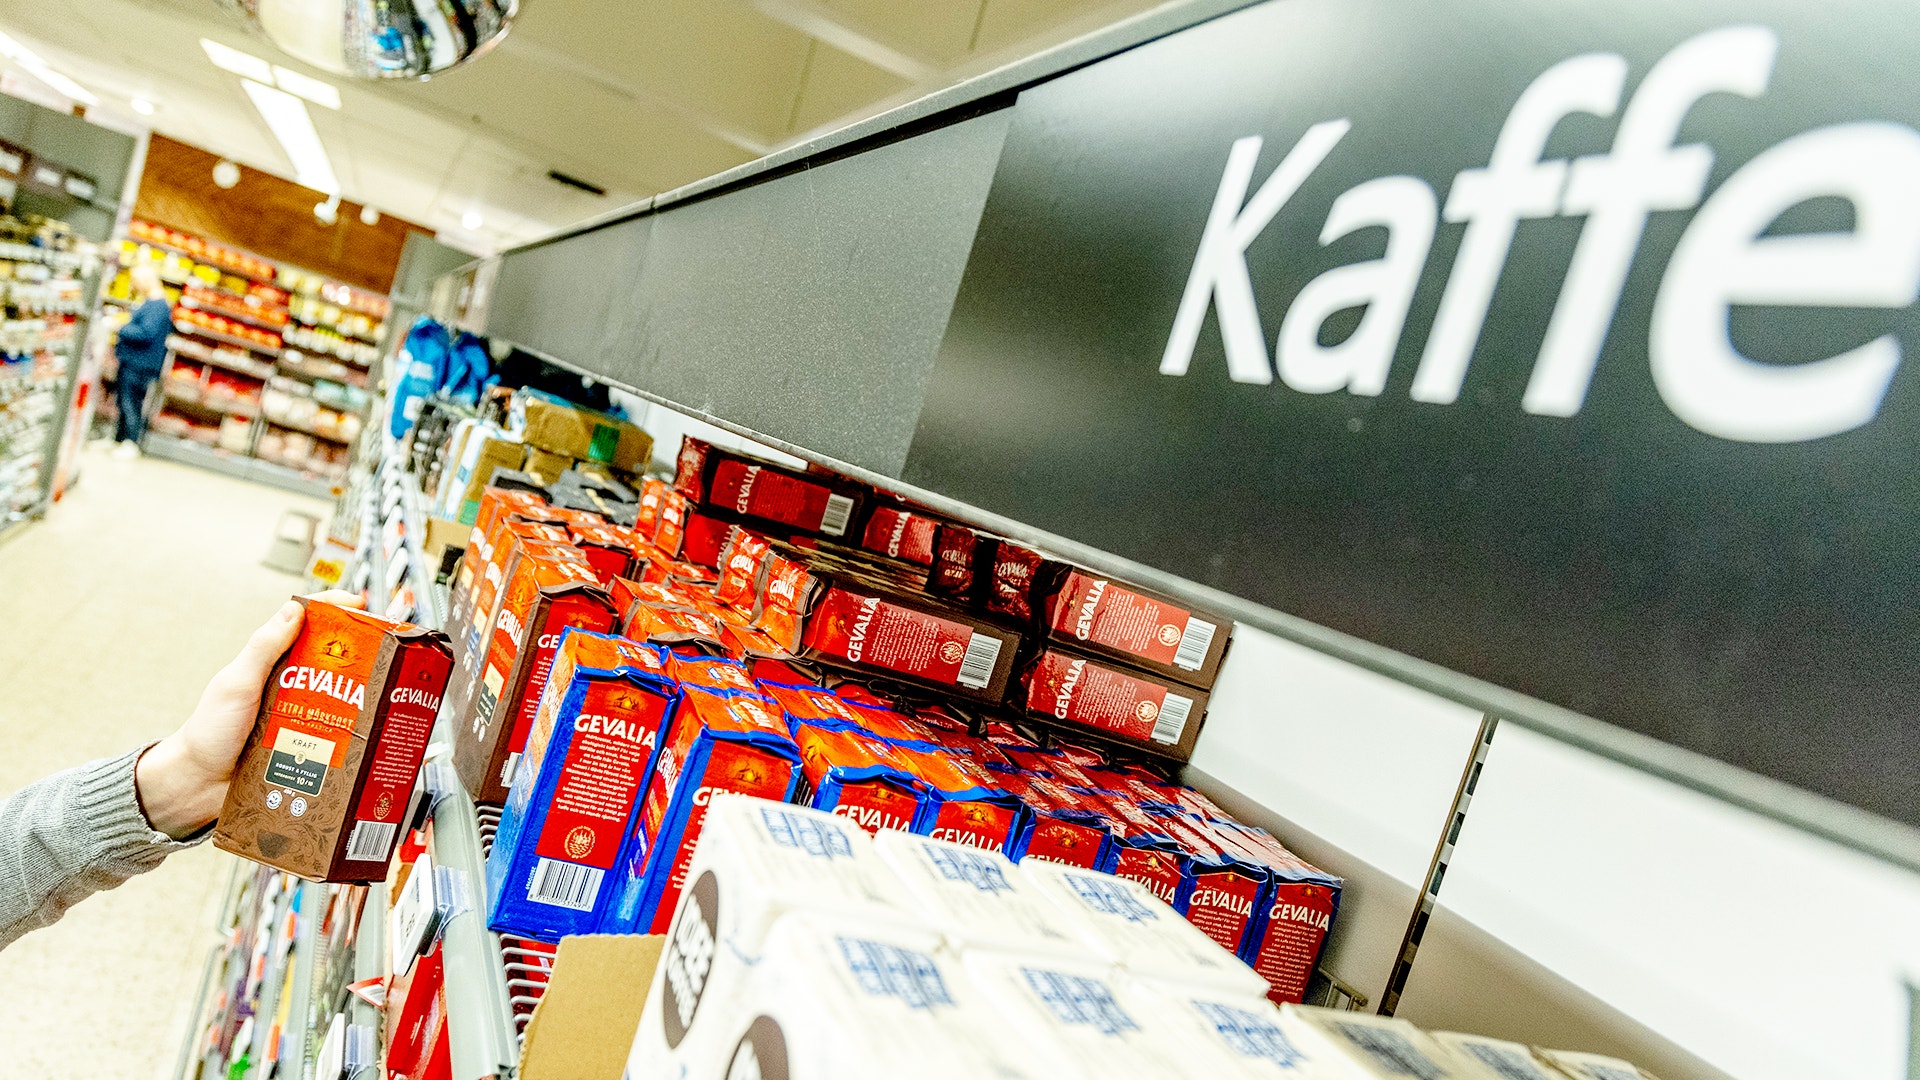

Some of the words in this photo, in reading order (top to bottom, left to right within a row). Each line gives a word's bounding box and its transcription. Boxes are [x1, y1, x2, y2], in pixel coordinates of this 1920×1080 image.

[1160, 25, 1920, 443] Kaffe
[736, 465, 762, 515] GEVALIA
[1075, 580, 1108, 641] GEVALIA
[846, 597, 881, 663] GEVALIA
[279, 666, 365, 711] GEVALIA
[390, 686, 441, 713] GEVALIA
[1054, 660, 1087, 719] GEVALIA
[277, 700, 304, 718] EXTRA
[292, 738, 318, 750] KRAFT
[574, 714, 656, 751] GEVALIA
[275, 762, 295, 773] ROBUST
[1189, 890, 1253, 918] GEVALIA
[1269, 904, 1330, 931] GEVALIA
